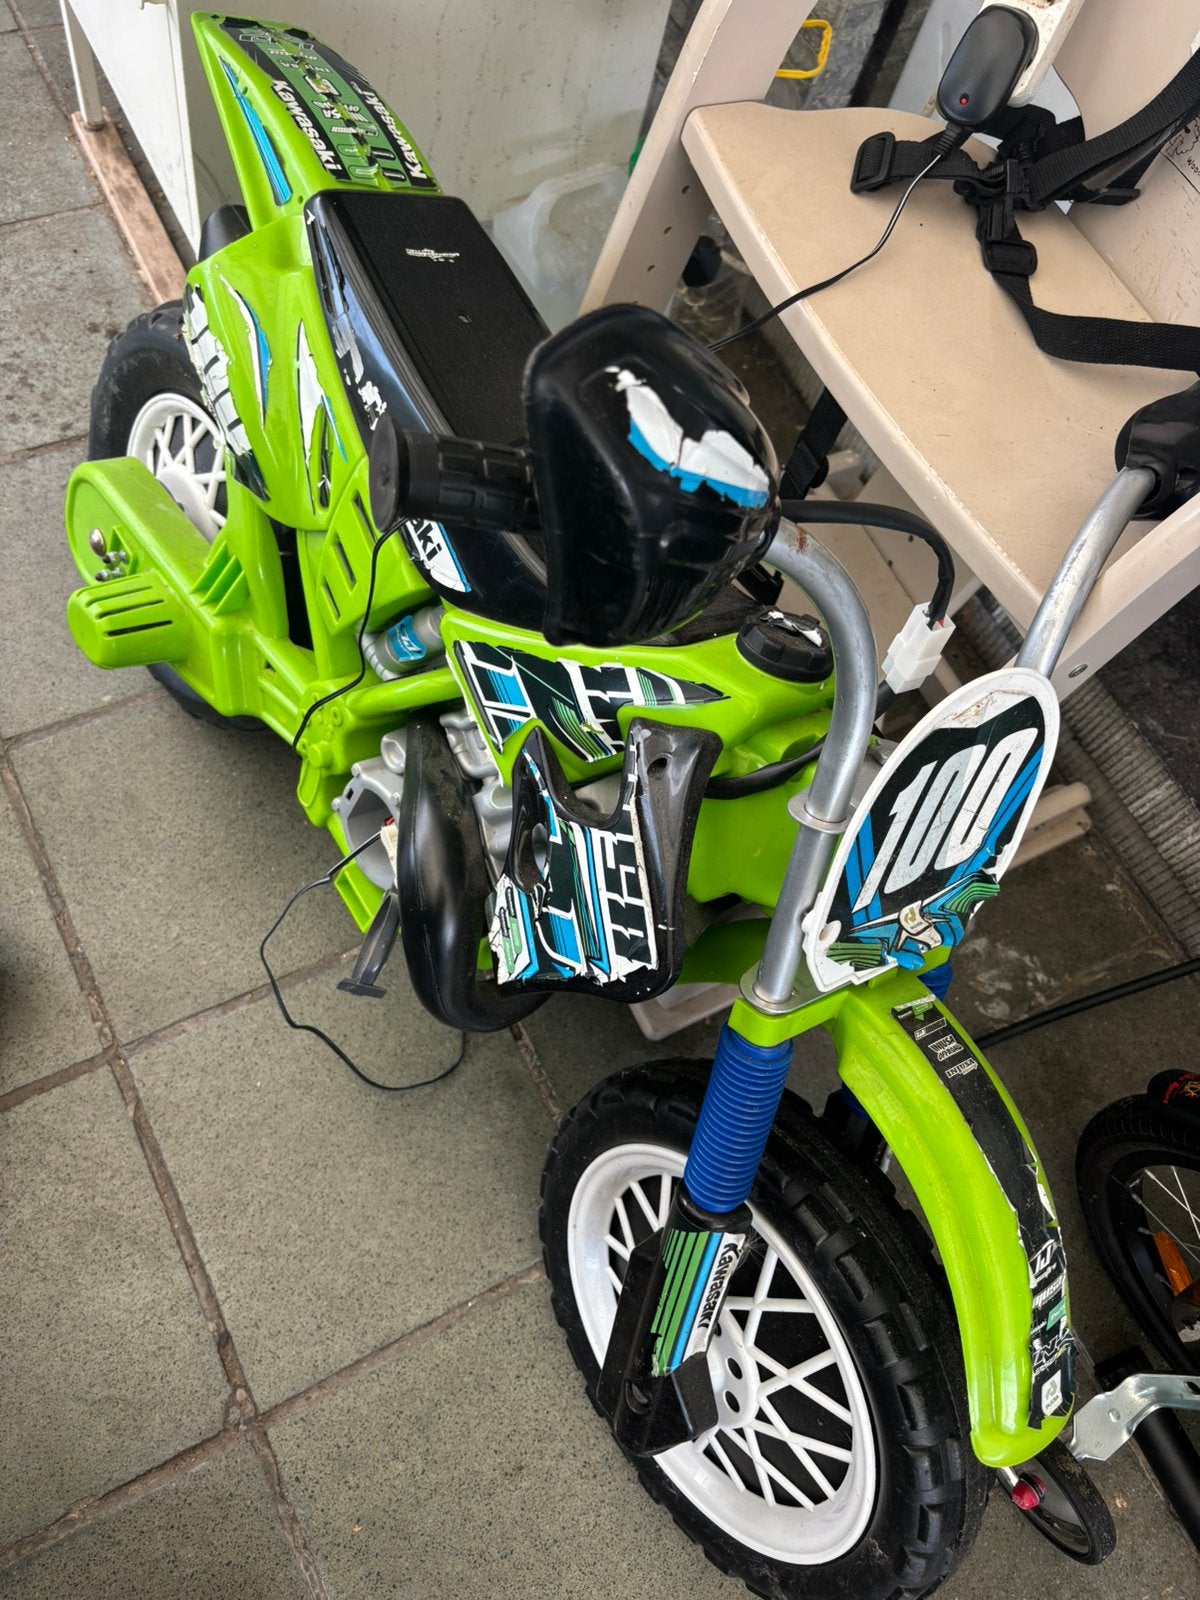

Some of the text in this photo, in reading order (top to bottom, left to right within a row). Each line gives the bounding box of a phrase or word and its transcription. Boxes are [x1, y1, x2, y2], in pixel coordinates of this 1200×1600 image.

[272, 79, 342, 171] Kawasaki
[359, 86, 428, 179] Kawasaki
[851, 727, 1038, 914] 100
[929, 1034, 957, 1052] INJUSA
[945, 1058, 976, 1077] INJUSA
[698, 1242, 743, 1329] Kawasaki
